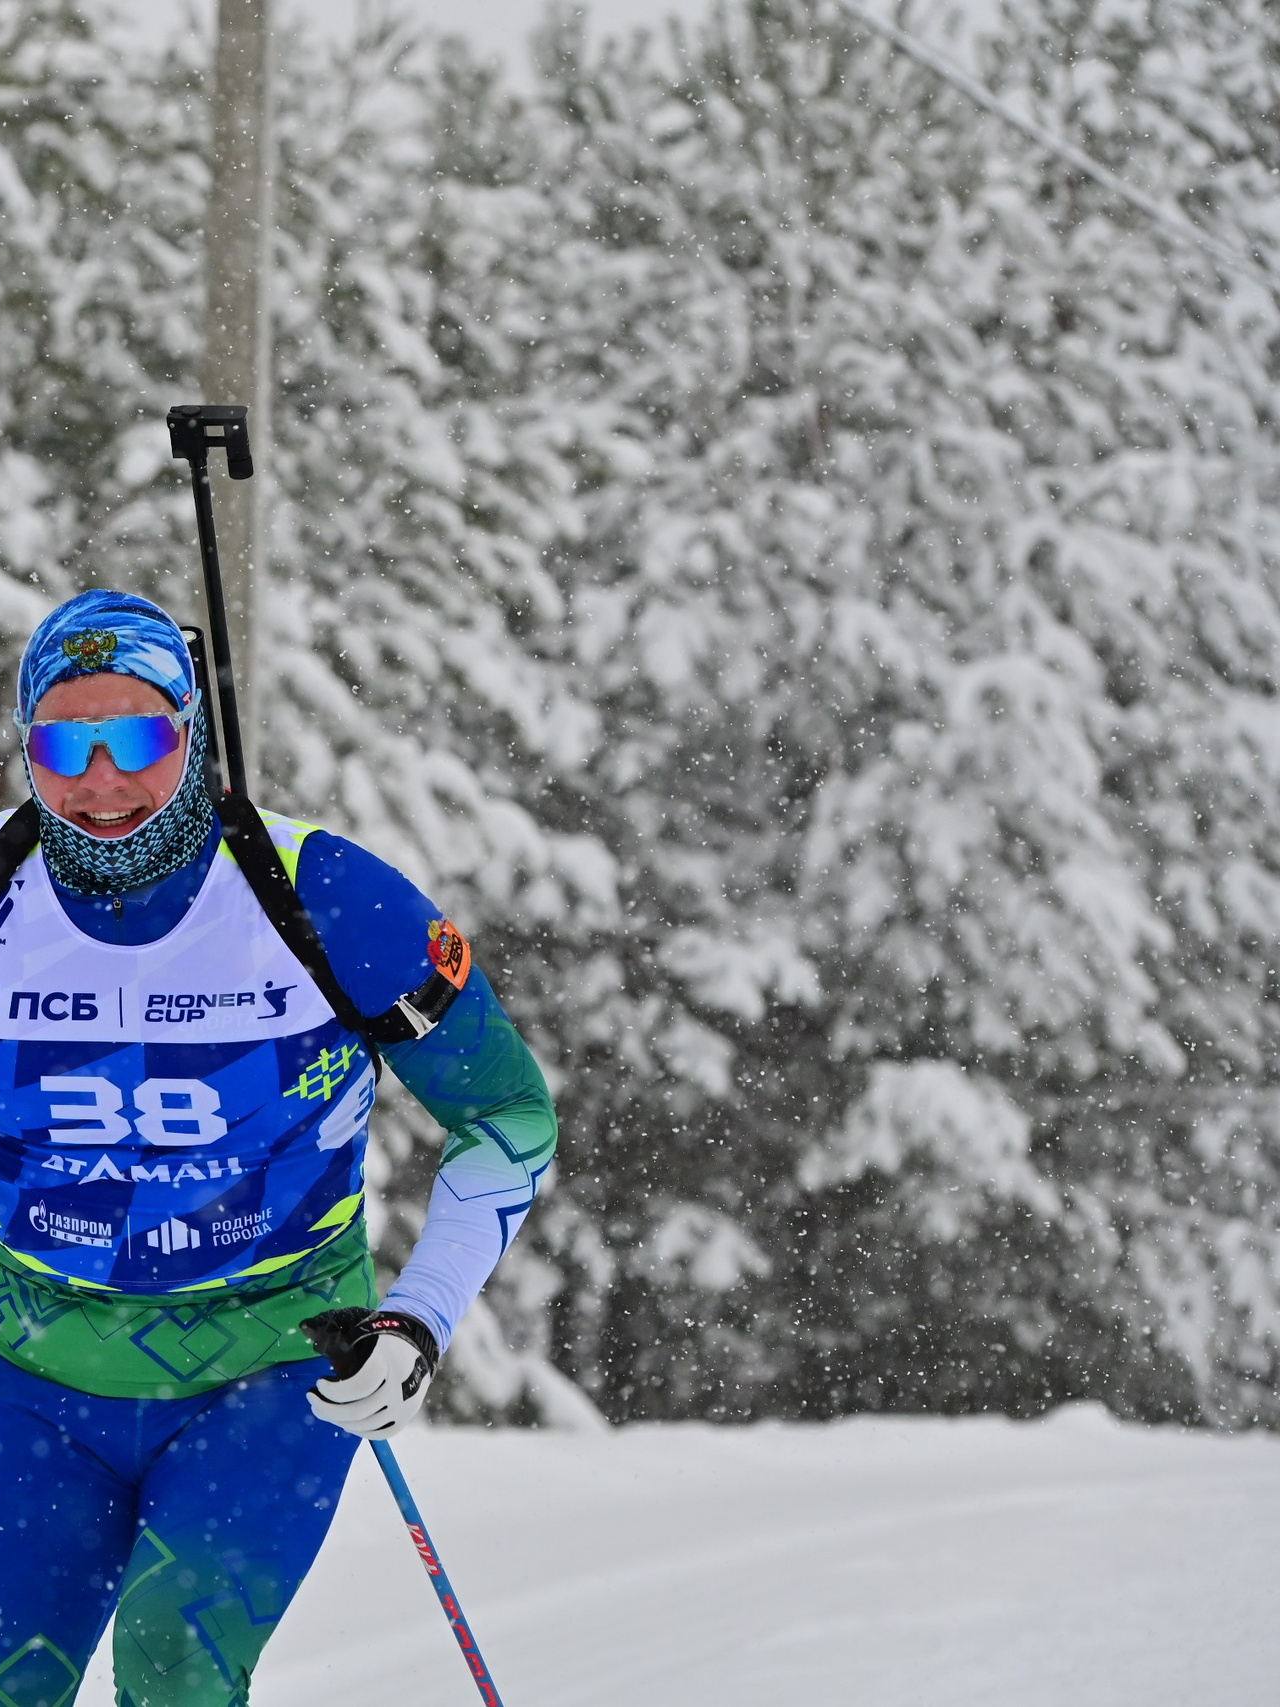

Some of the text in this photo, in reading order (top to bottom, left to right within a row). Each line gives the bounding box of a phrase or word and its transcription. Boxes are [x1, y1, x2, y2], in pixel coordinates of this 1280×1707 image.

[9, 991, 99, 1021] ПСБ
[147, 992, 256, 1008] PIONER
[144, 1009, 206, 1023] CUP
[40, 1076, 228, 1147] 38
[49, 1212, 112, 1237] ГАЗПРОМ
[212, 1207, 273, 1233] РОДНЫЕ
[212, 1223, 273, 1247] ГОРОДА
